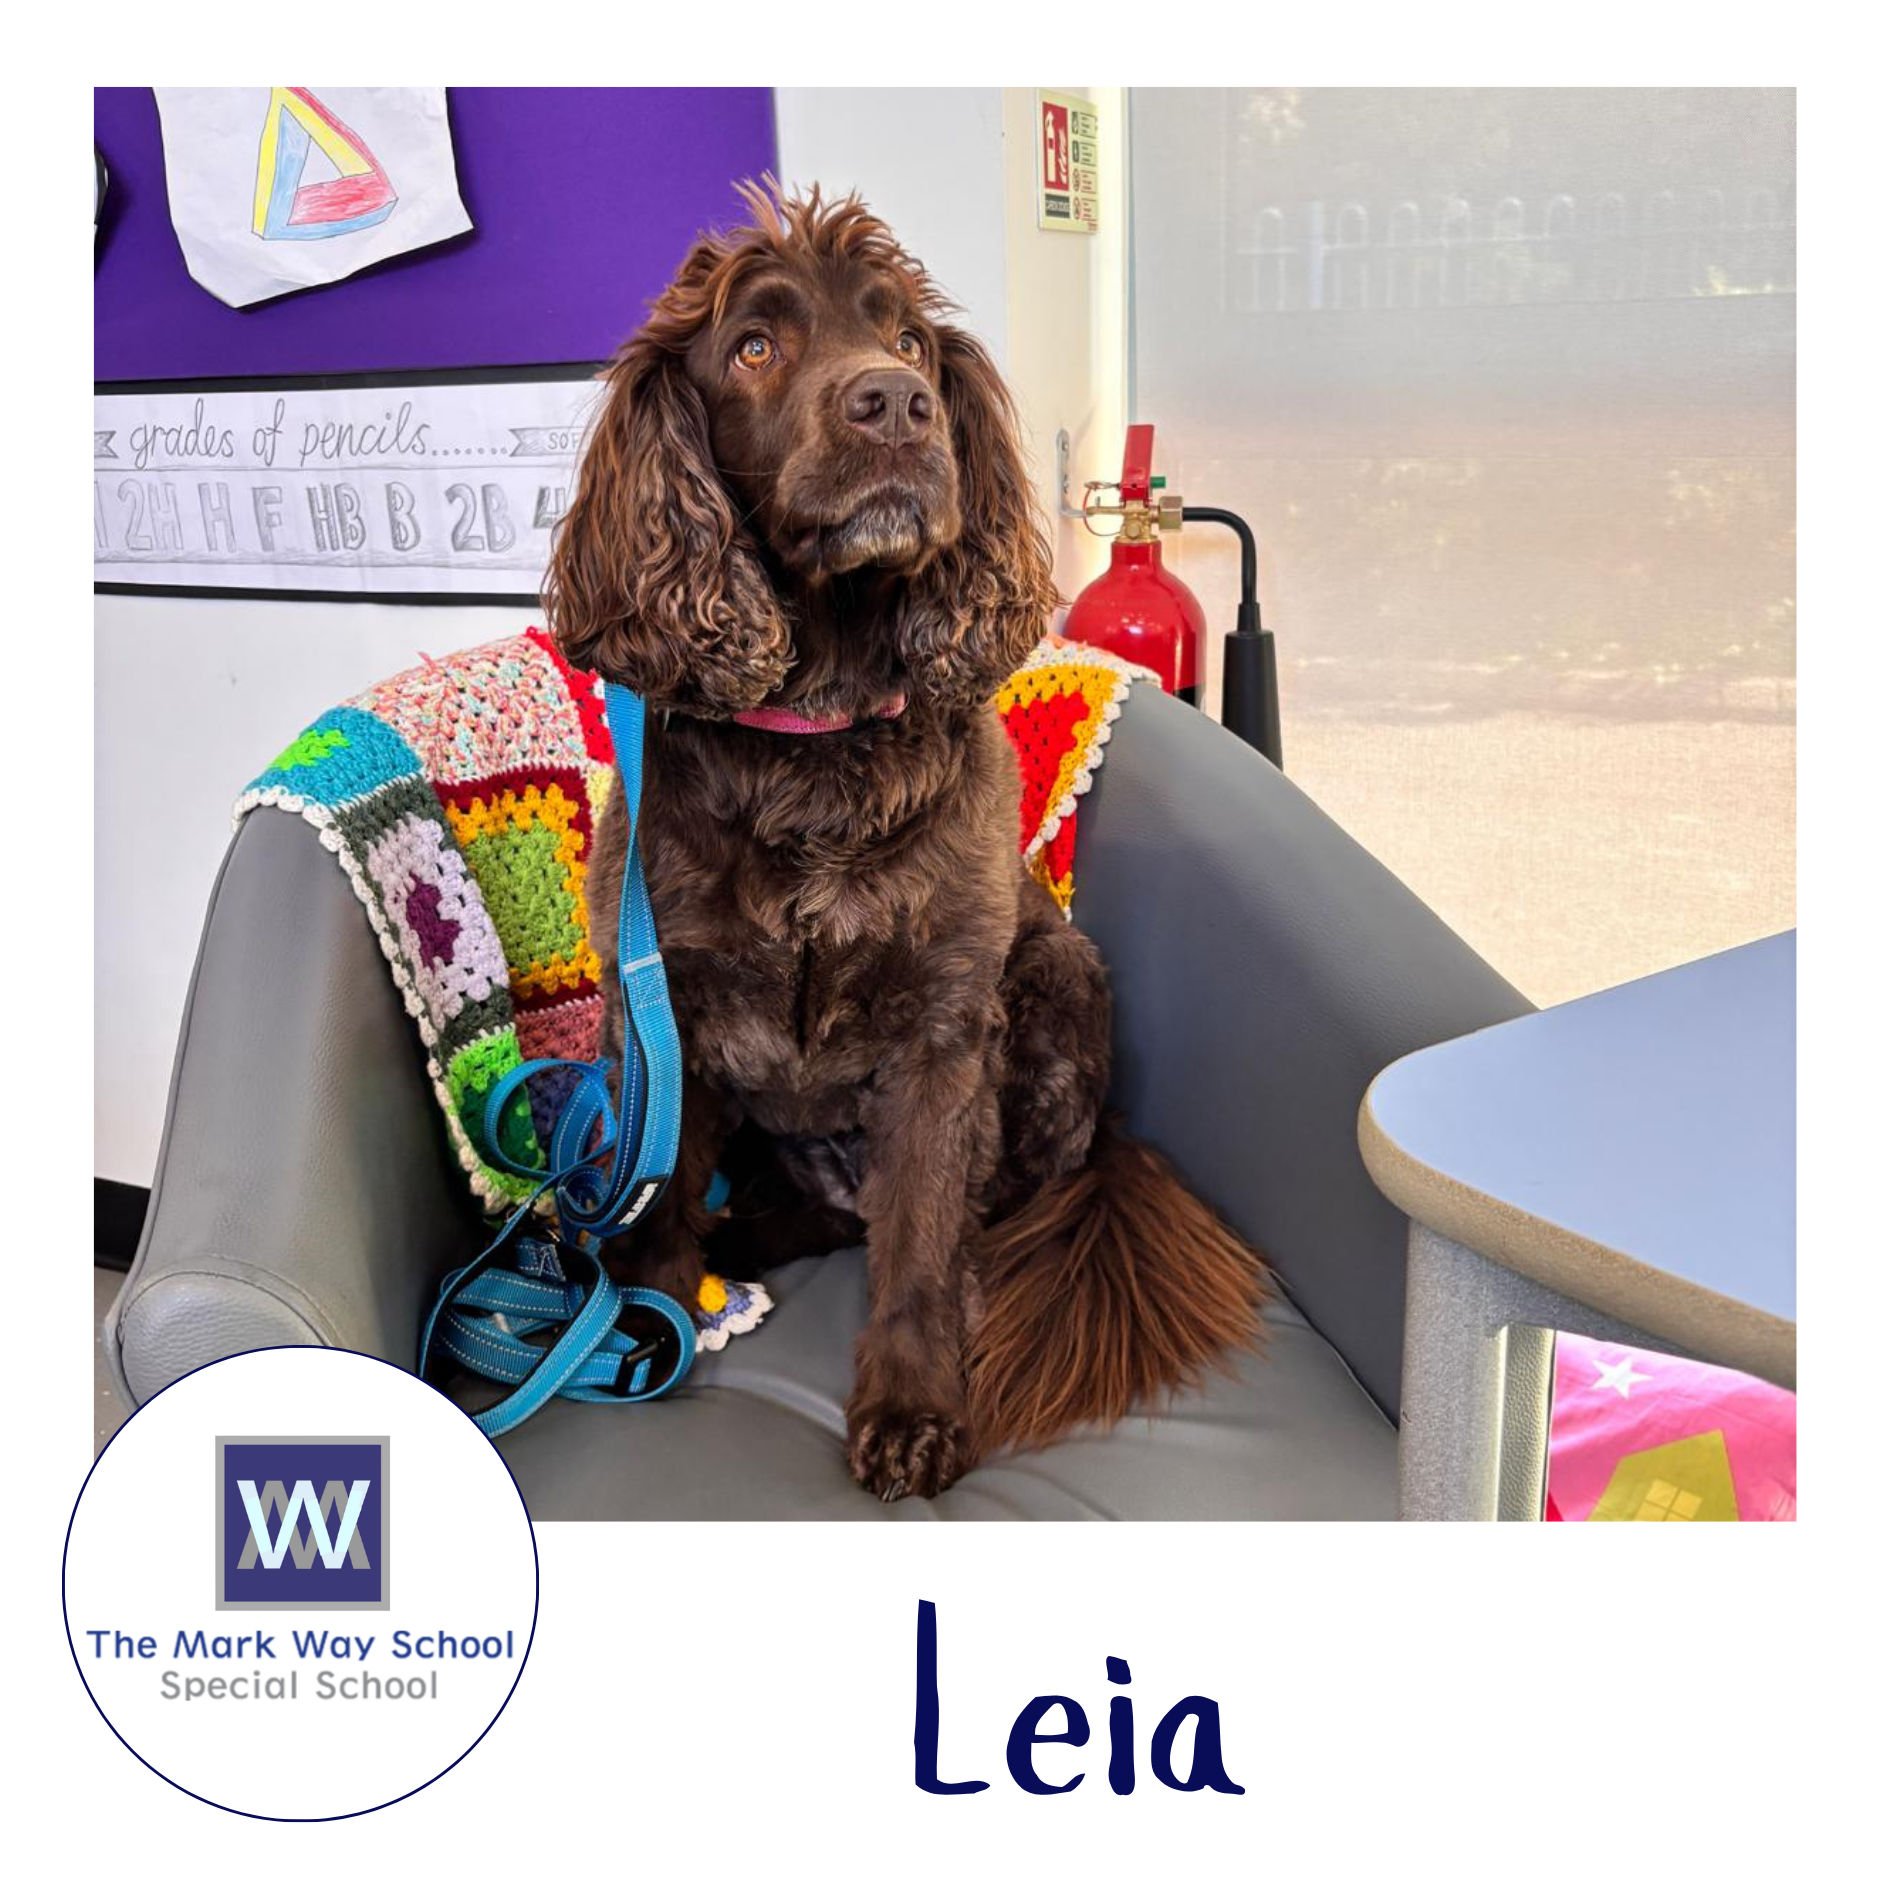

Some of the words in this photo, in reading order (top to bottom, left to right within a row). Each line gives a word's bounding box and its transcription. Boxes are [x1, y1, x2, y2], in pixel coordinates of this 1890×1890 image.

[130, 397, 235, 470] grades
[252, 398, 286, 468] of
[117, 478, 184, 551] 2H
[197, 482, 238, 552] H
[252, 486, 284, 552] F
[306, 482, 367, 552] HB
[385, 481, 421, 552] B
[444, 483, 516, 553] 2B
